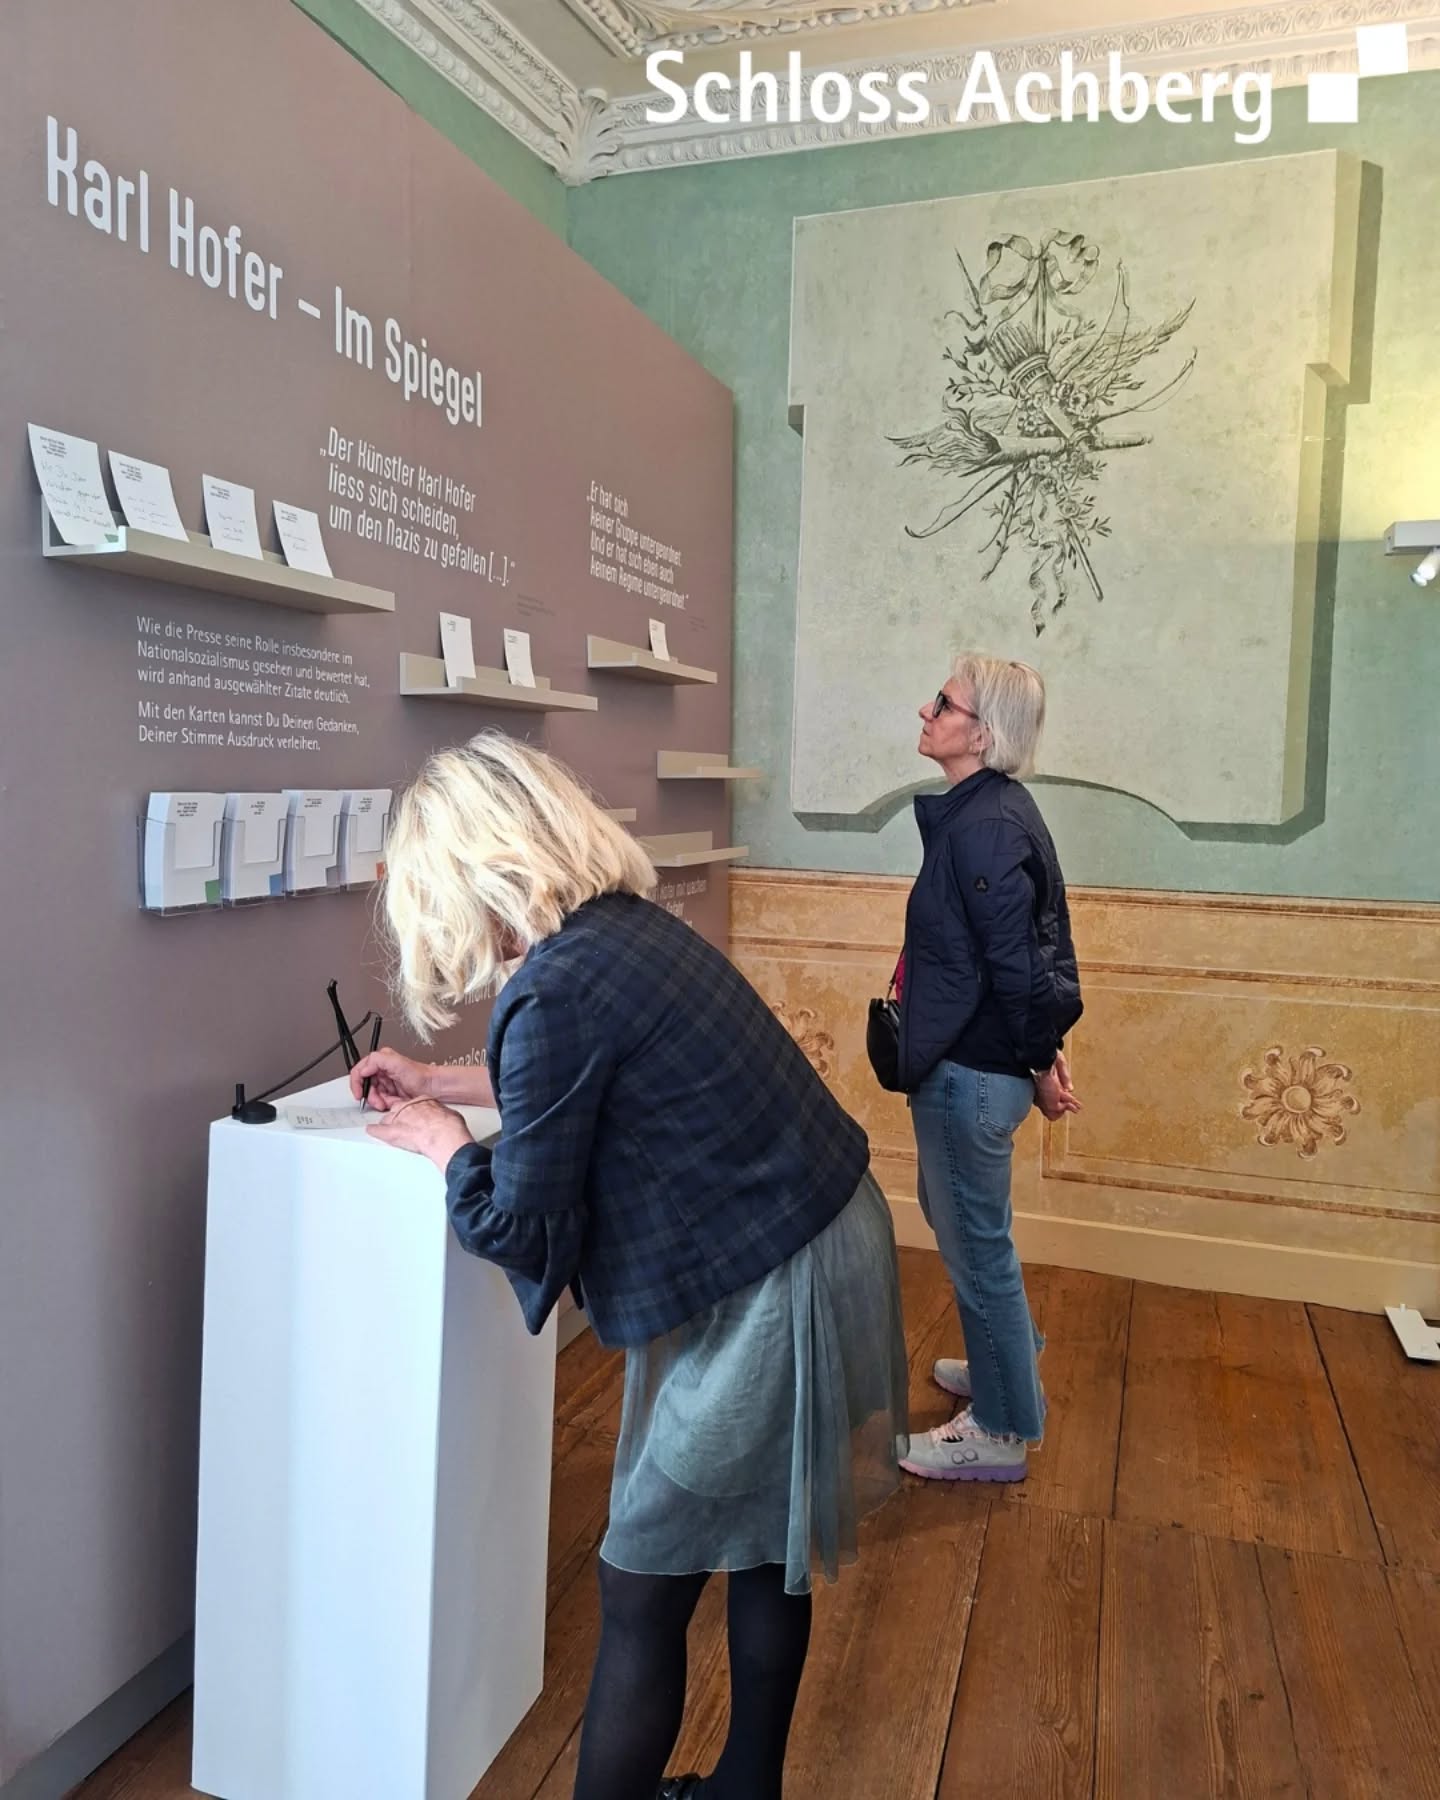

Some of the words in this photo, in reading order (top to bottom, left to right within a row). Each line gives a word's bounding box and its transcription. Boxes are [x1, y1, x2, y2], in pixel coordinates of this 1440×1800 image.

[47, 115, 149, 253] Karl
[169, 187, 283, 320] Hofer
[335, 285, 373, 370] Im
[385, 317, 482, 428] Spiegel
[358, 439, 415, 489] Künstler
[418, 465, 442, 500] Karl
[445, 477, 476, 513] Hofer
[328, 463, 365, 502] liess
[368, 481, 397, 515] sich
[401, 496, 460, 540] scheiden,
[329, 504, 352, 533] um
[356, 509, 382, 543] den
[386, 517, 421, 555] Nazis
[424, 536, 438, 560] zu
[441, 542, 486, 577] gefallen
[136, 615, 161, 635] Wie
[164, 620, 183, 639] die
[186, 624, 222, 645] Presse
[224, 632, 252, 650] seine
[255, 635, 280, 654] Rolle
[282, 640, 340, 664] insbesondere
[342, 650, 353, 665] im
[137, 640, 250, 671] Nationalsozialismus
[253, 660, 293, 677] gesehen
[295, 665, 313, 680] und
[315, 666, 353, 685] bewertet
[136, 665, 165, 684] wird
[168, 670, 211, 689] anhand
[214, 677, 282, 697] ausgewählter
[284, 682, 313, 700] Zitate
[138, 700, 160, 719] Mit
[163, 703, 186, 721] den
[188, 705, 226, 724] Karten
[228, 709, 263, 727] kannst
[266, 711, 280, 728] Du
[282, 713, 314, 730] Deinen
[316, 716, 360, 736] Gedanken,
[138, 724, 178, 744] Deiner
[181, 726, 225, 747] Stimme
[226, 730, 275, 749] Ausdruck
[276, 734, 321, 751] verleihen.
